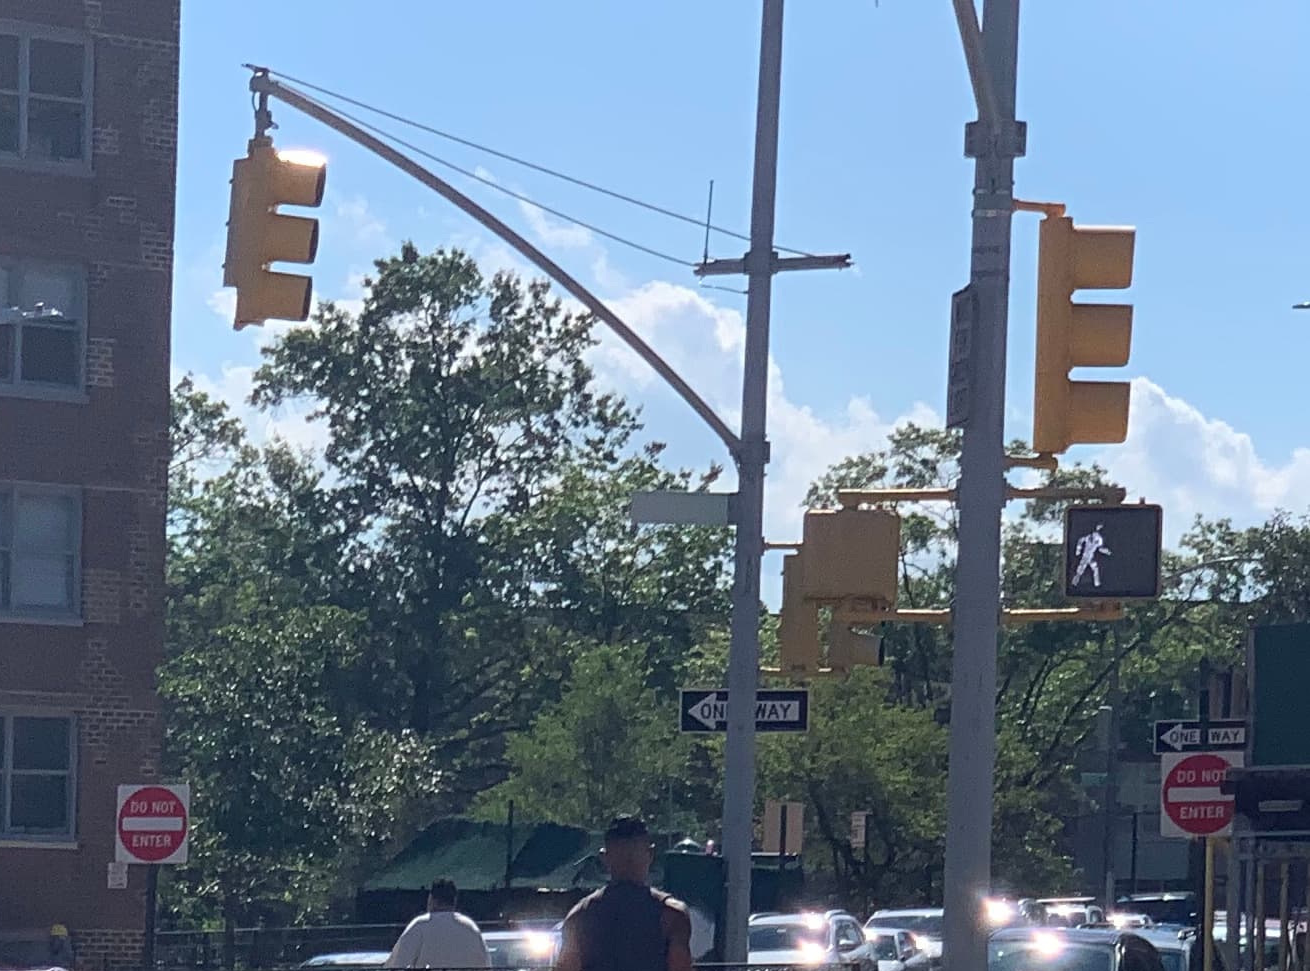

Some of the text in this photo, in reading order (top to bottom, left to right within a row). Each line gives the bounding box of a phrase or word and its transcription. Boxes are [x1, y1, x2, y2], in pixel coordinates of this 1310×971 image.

[700, 703, 724, 720] ON
[1169, 730, 1240, 743] ONE WAY
[1176, 770, 1195, 783] DO
[130, 801, 177, 813] DO NOT
[1179, 806, 1224, 819] ENTER
[132, 835, 171, 848] ENTER
